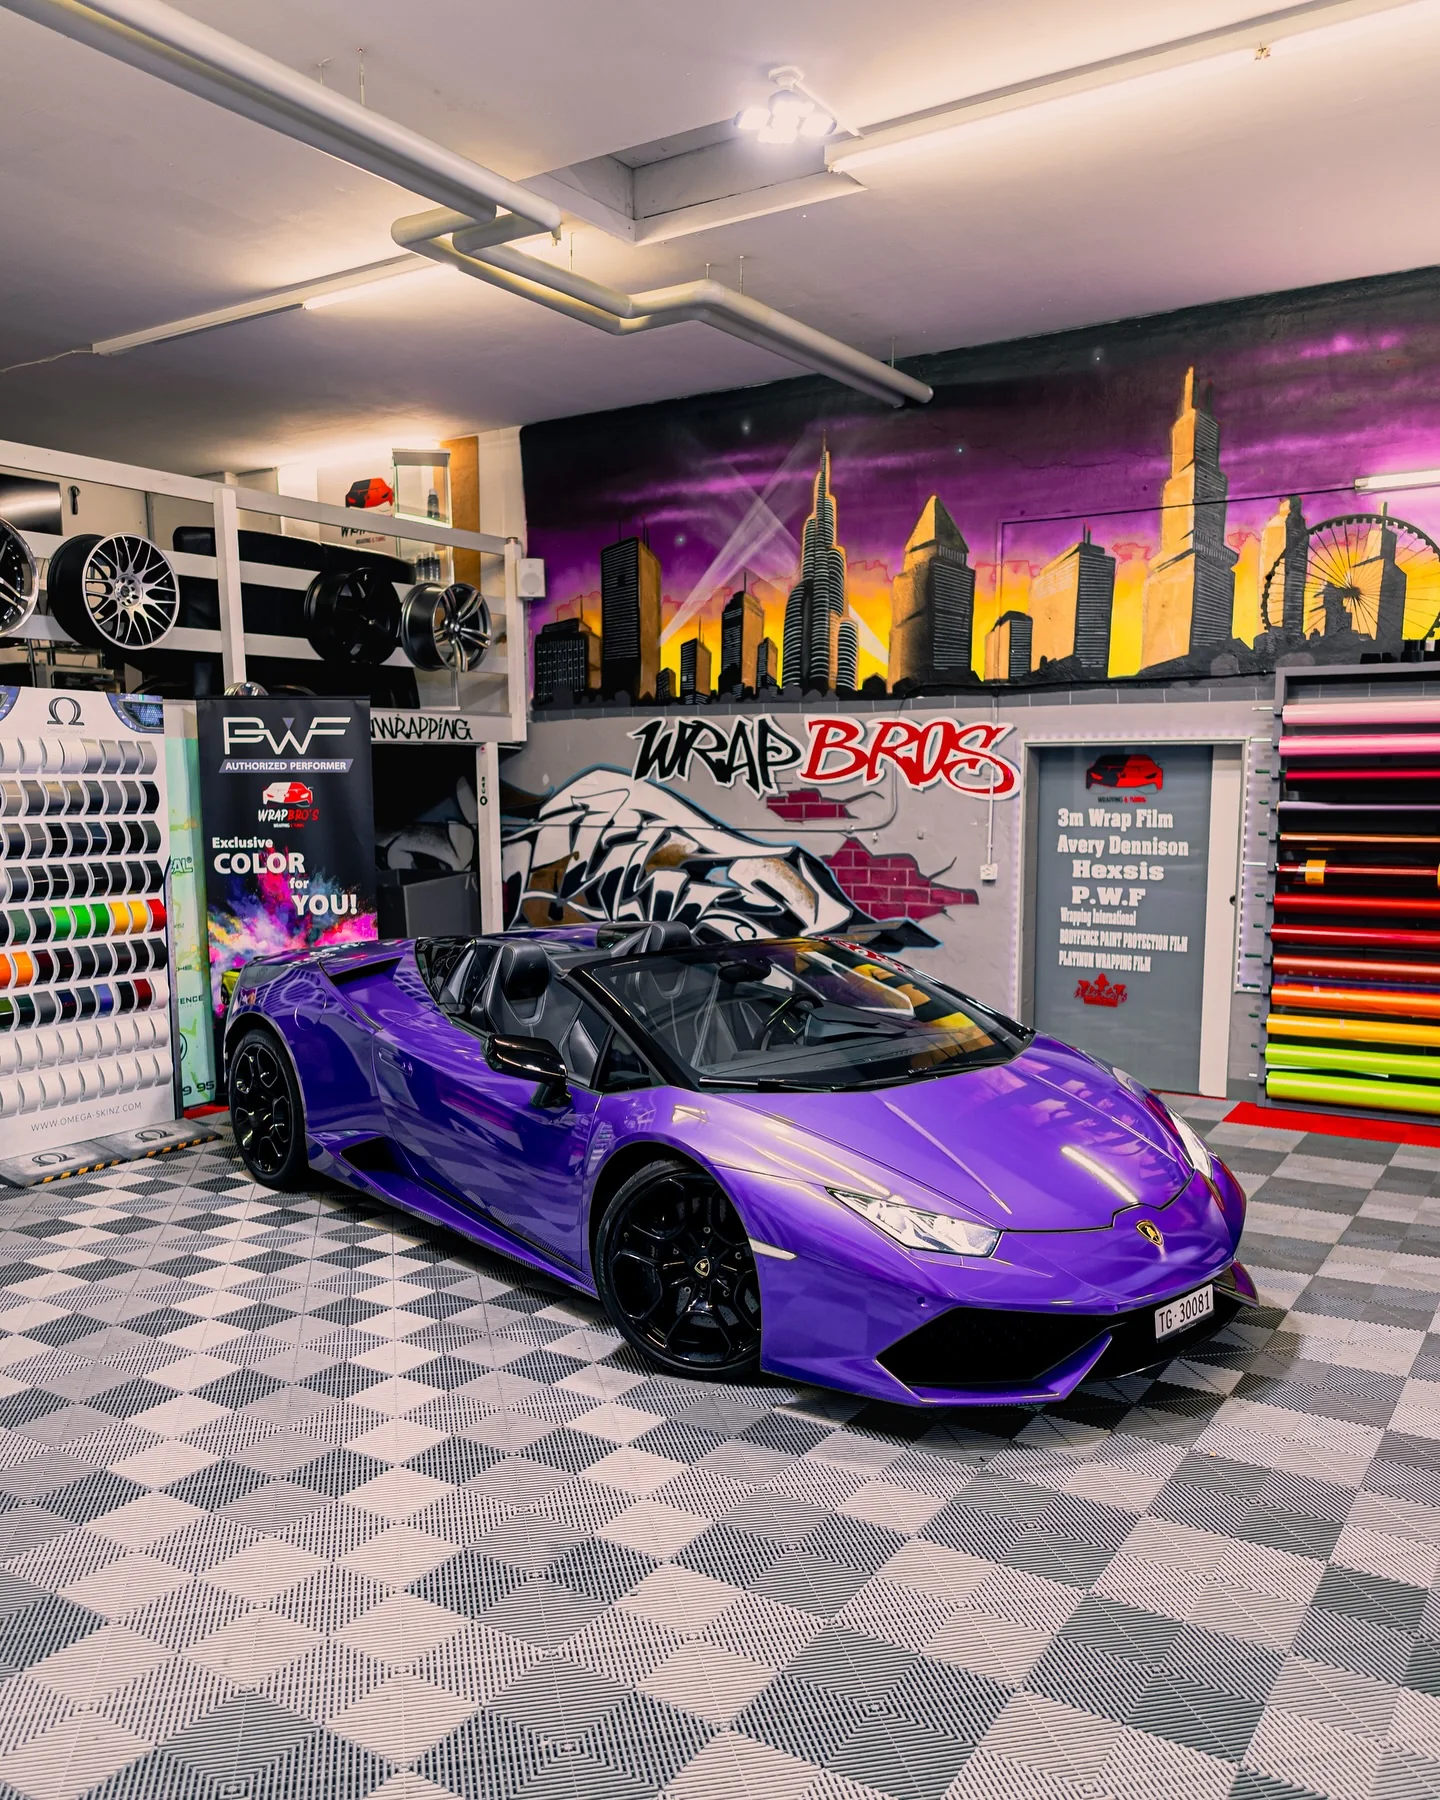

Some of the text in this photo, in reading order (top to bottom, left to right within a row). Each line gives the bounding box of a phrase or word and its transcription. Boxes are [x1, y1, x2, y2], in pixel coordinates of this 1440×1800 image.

[223, 717, 351, 755] PWF
[225, 761, 347, 771] AUTHORIZED PERFORMER
[630, 714, 1018, 798] WRAP BROS
[1057, 807, 1174, 832] 3m Wrap Film
[212, 836, 274, 849] Exclusive
[1057, 834, 1189, 858] Avery Dennison
[213, 852, 306, 875] COLOR
[1072, 859, 1165, 881] Hexsis
[289, 877, 309, 889] for
[291, 894, 358, 916] YOU!
[1071, 885, 1147, 907] P.W.F
[1060, 906, 1137, 927] Wrapping International
[1100, 931, 1122, 948] PAINT
[1122, 932, 1169, 951] PROTECTION
[1169, 935, 1188, 953] FILM
[1059, 950, 1151, 972] PLATINUM WRAPPING FILM
[178, 994, 205, 1005] ENCE
[31, 1101, 143, 1132] WWW.OMEGA-SKINZ.COM
